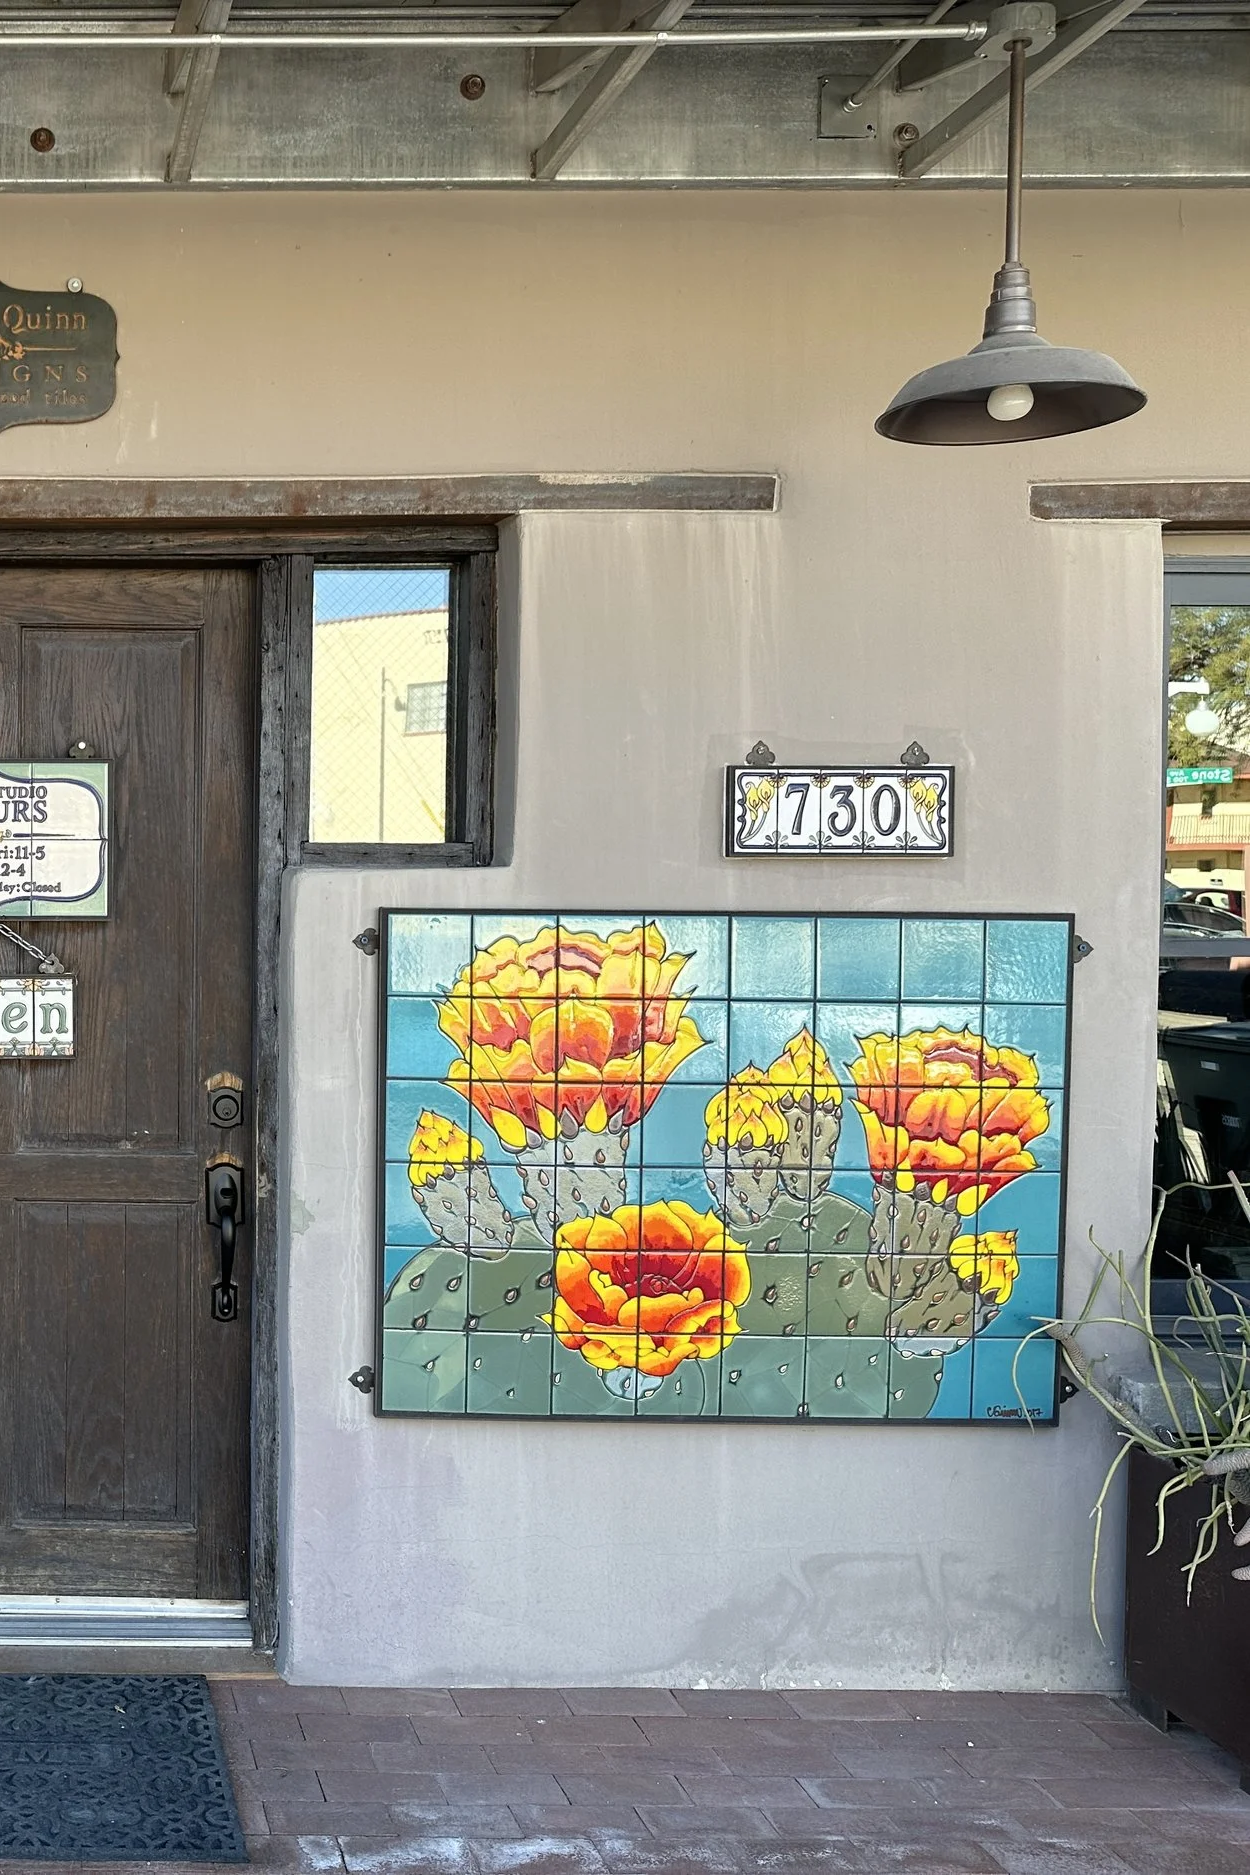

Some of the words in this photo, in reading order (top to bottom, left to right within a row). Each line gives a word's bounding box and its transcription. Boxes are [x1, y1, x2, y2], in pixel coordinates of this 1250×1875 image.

[3, 304, 86, 334] Quinn
[45, 389, 87, 405] tiles
[785, 783, 901, 836] 730
